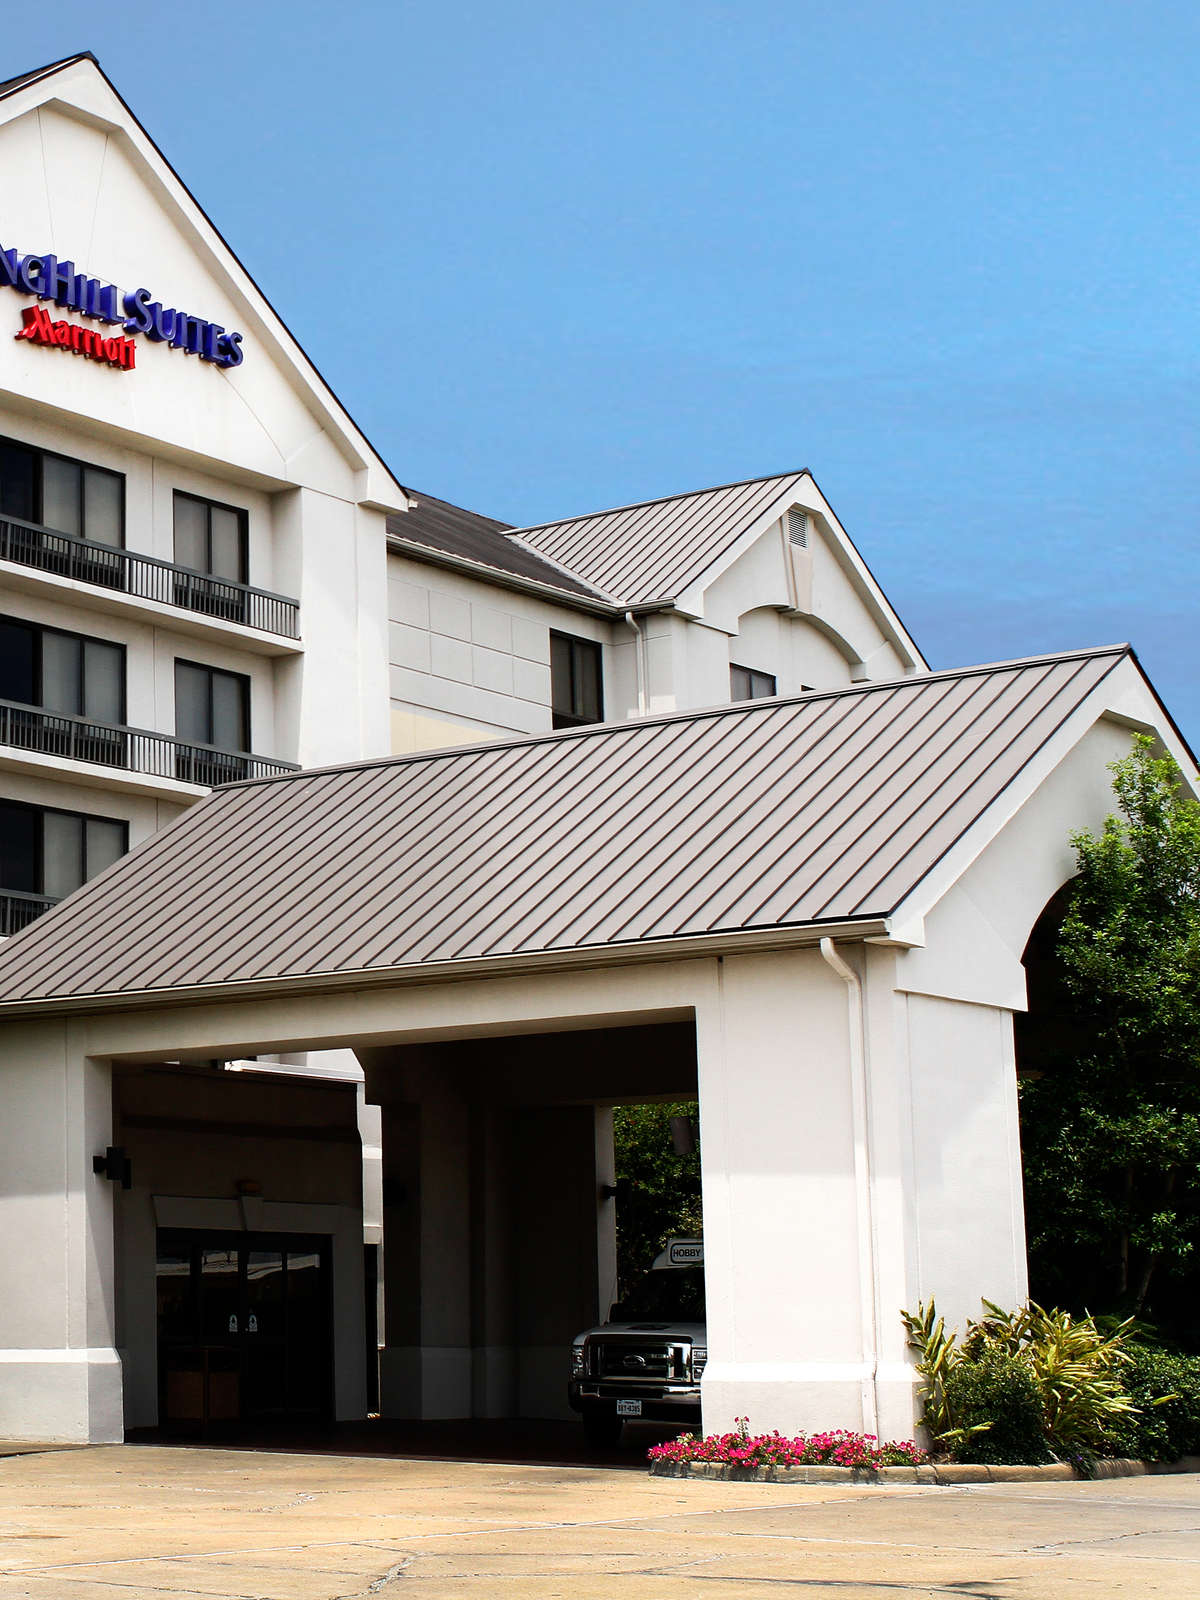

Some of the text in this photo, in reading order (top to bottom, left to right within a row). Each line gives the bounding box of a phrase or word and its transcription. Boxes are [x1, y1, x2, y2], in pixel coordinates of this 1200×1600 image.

[15, 304, 137, 371] Marriott
[123, 288, 244, 368] SUITES
[673, 1249, 700, 1257] HOBBY
